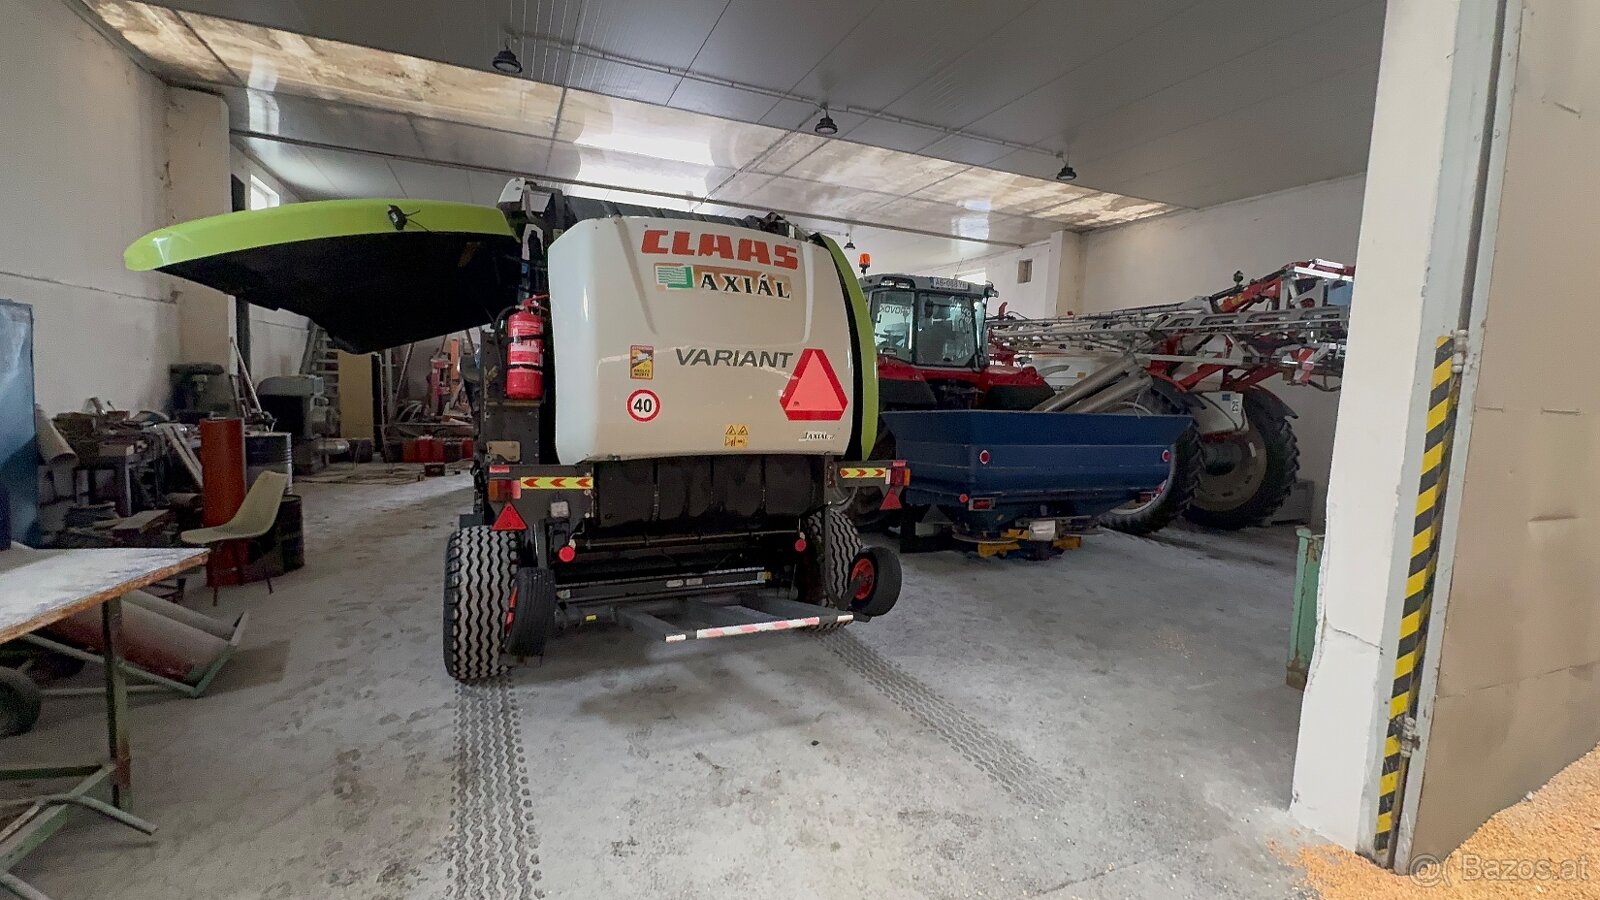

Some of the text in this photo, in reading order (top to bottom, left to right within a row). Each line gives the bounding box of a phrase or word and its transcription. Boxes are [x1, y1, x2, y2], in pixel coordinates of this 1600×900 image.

[641, 229, 798, 270] CLAAS
[701, 273, 790, 298] AXIÁL
[676, 348, 793, 368] VARIANT
[634, 395, 653, 412] 40
